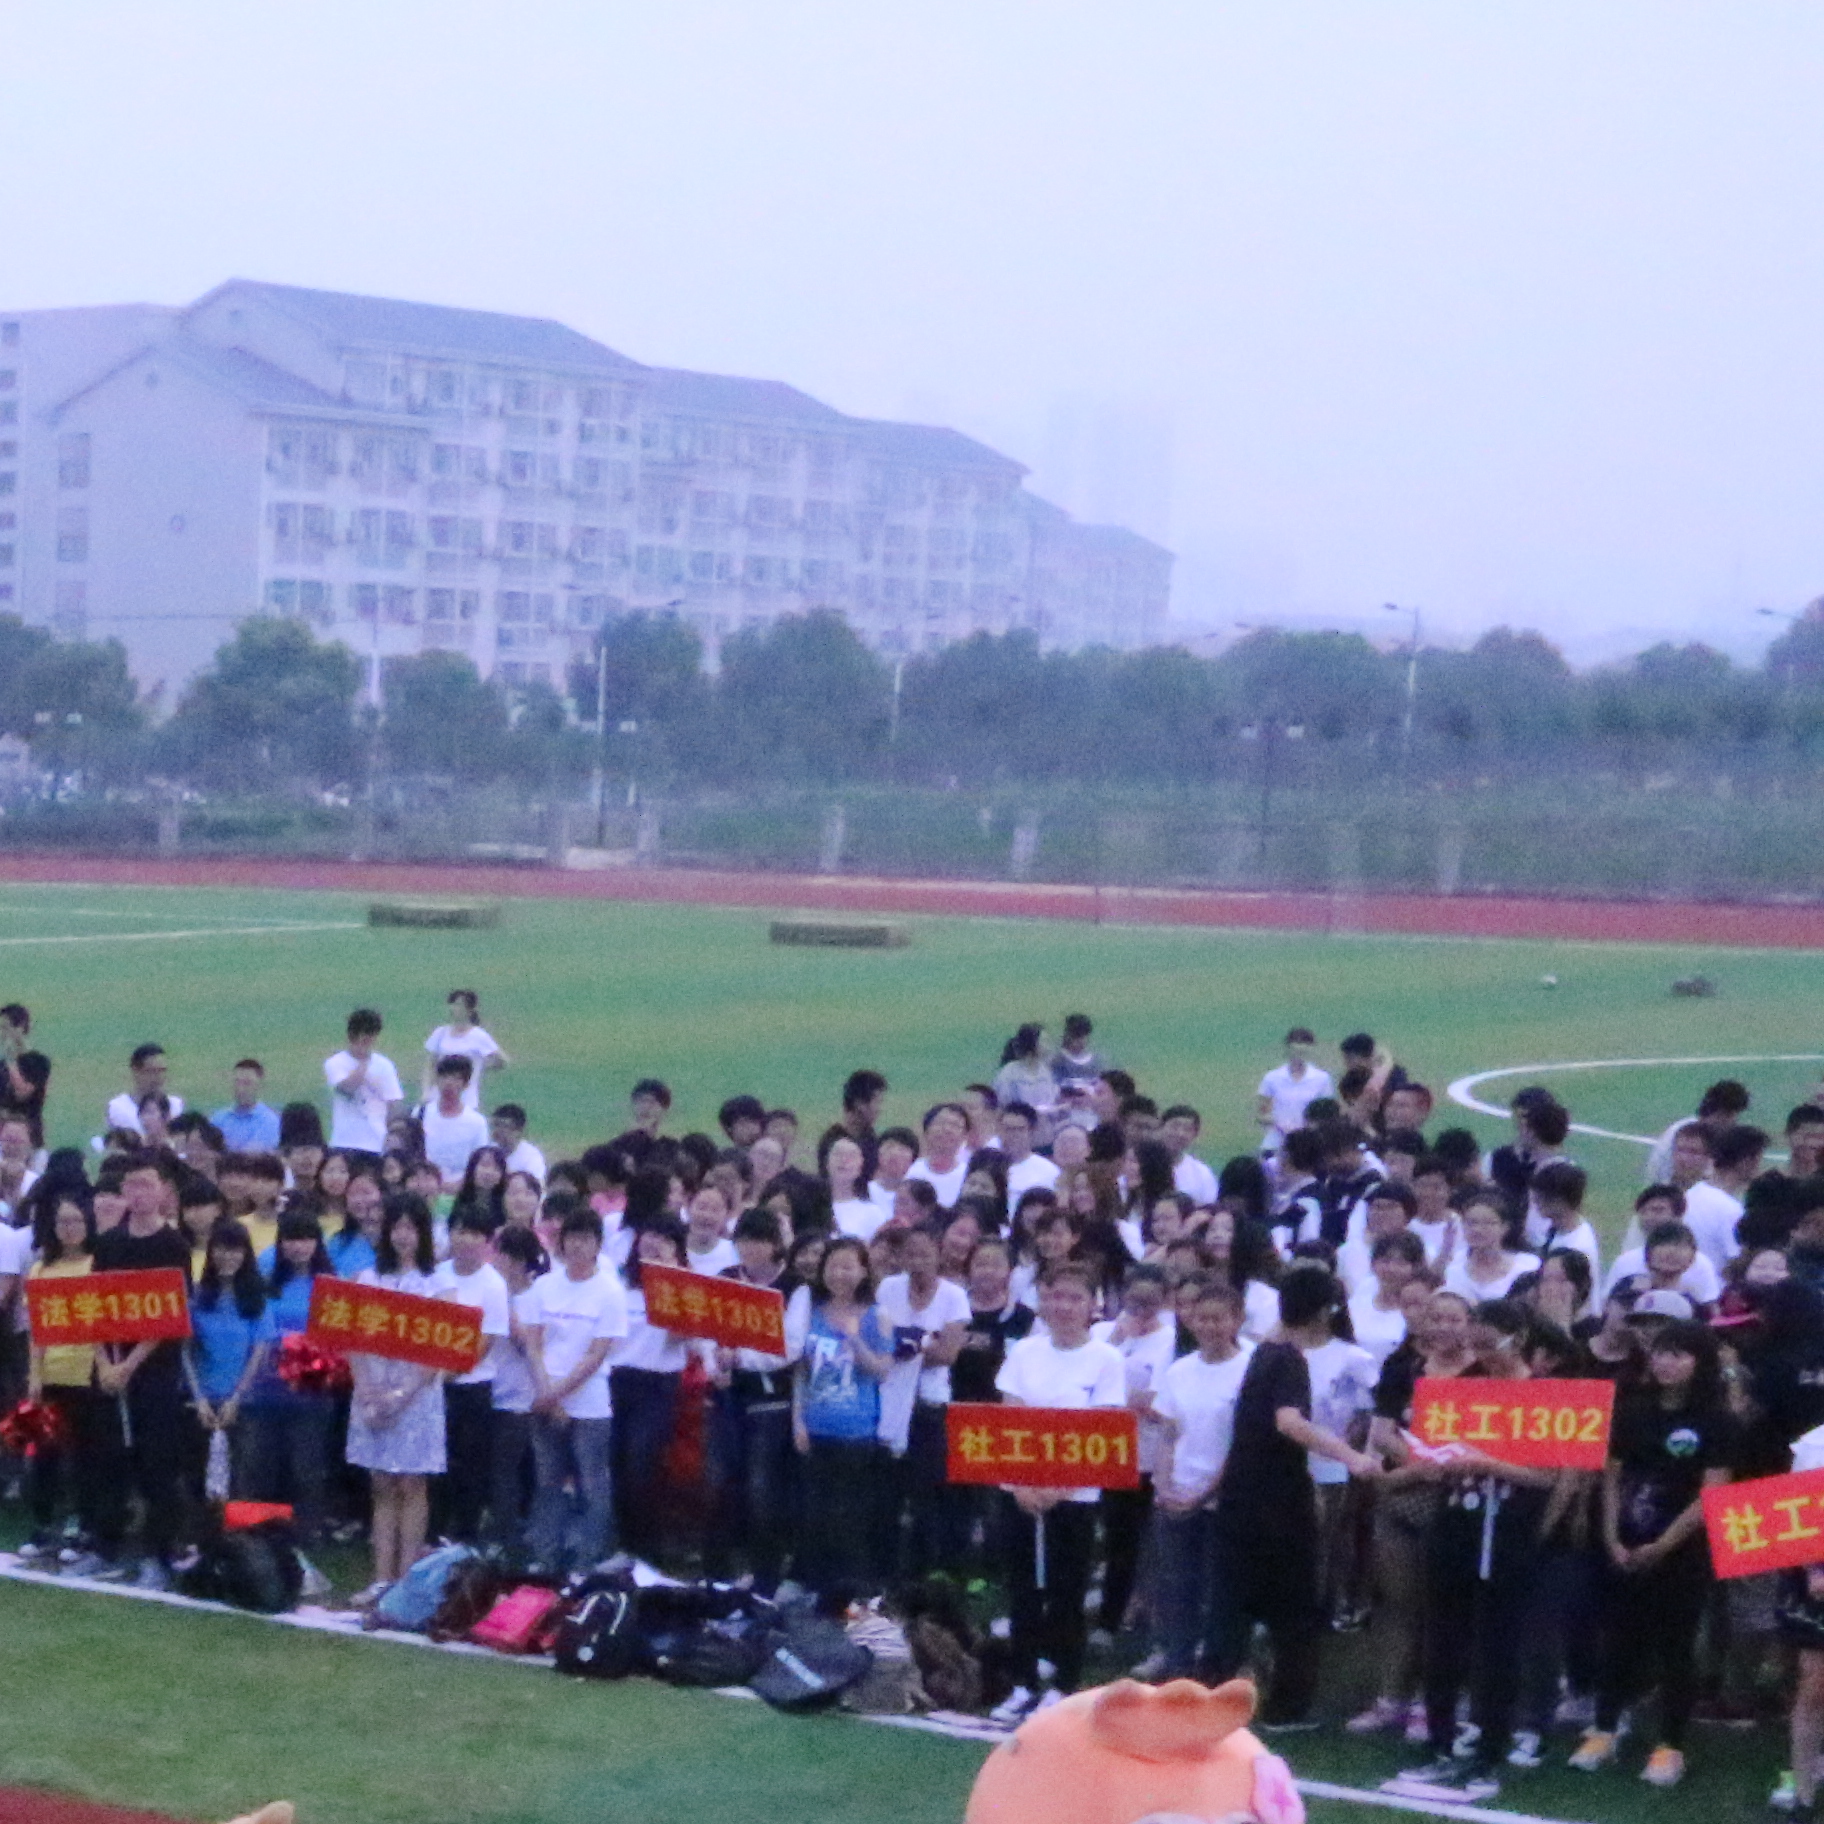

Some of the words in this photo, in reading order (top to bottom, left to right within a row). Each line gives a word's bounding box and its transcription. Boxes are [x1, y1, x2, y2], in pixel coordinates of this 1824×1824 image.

[40, 1291, 180, 1327] 法学1301
[319, 1295, 475, 1353] 法学1302
[1424, 1402, 1603, 1441] 社工1302
[959, 1425, 1128, 1465] 社工1301
[1721, 1496, 1824, 1554] 社工
